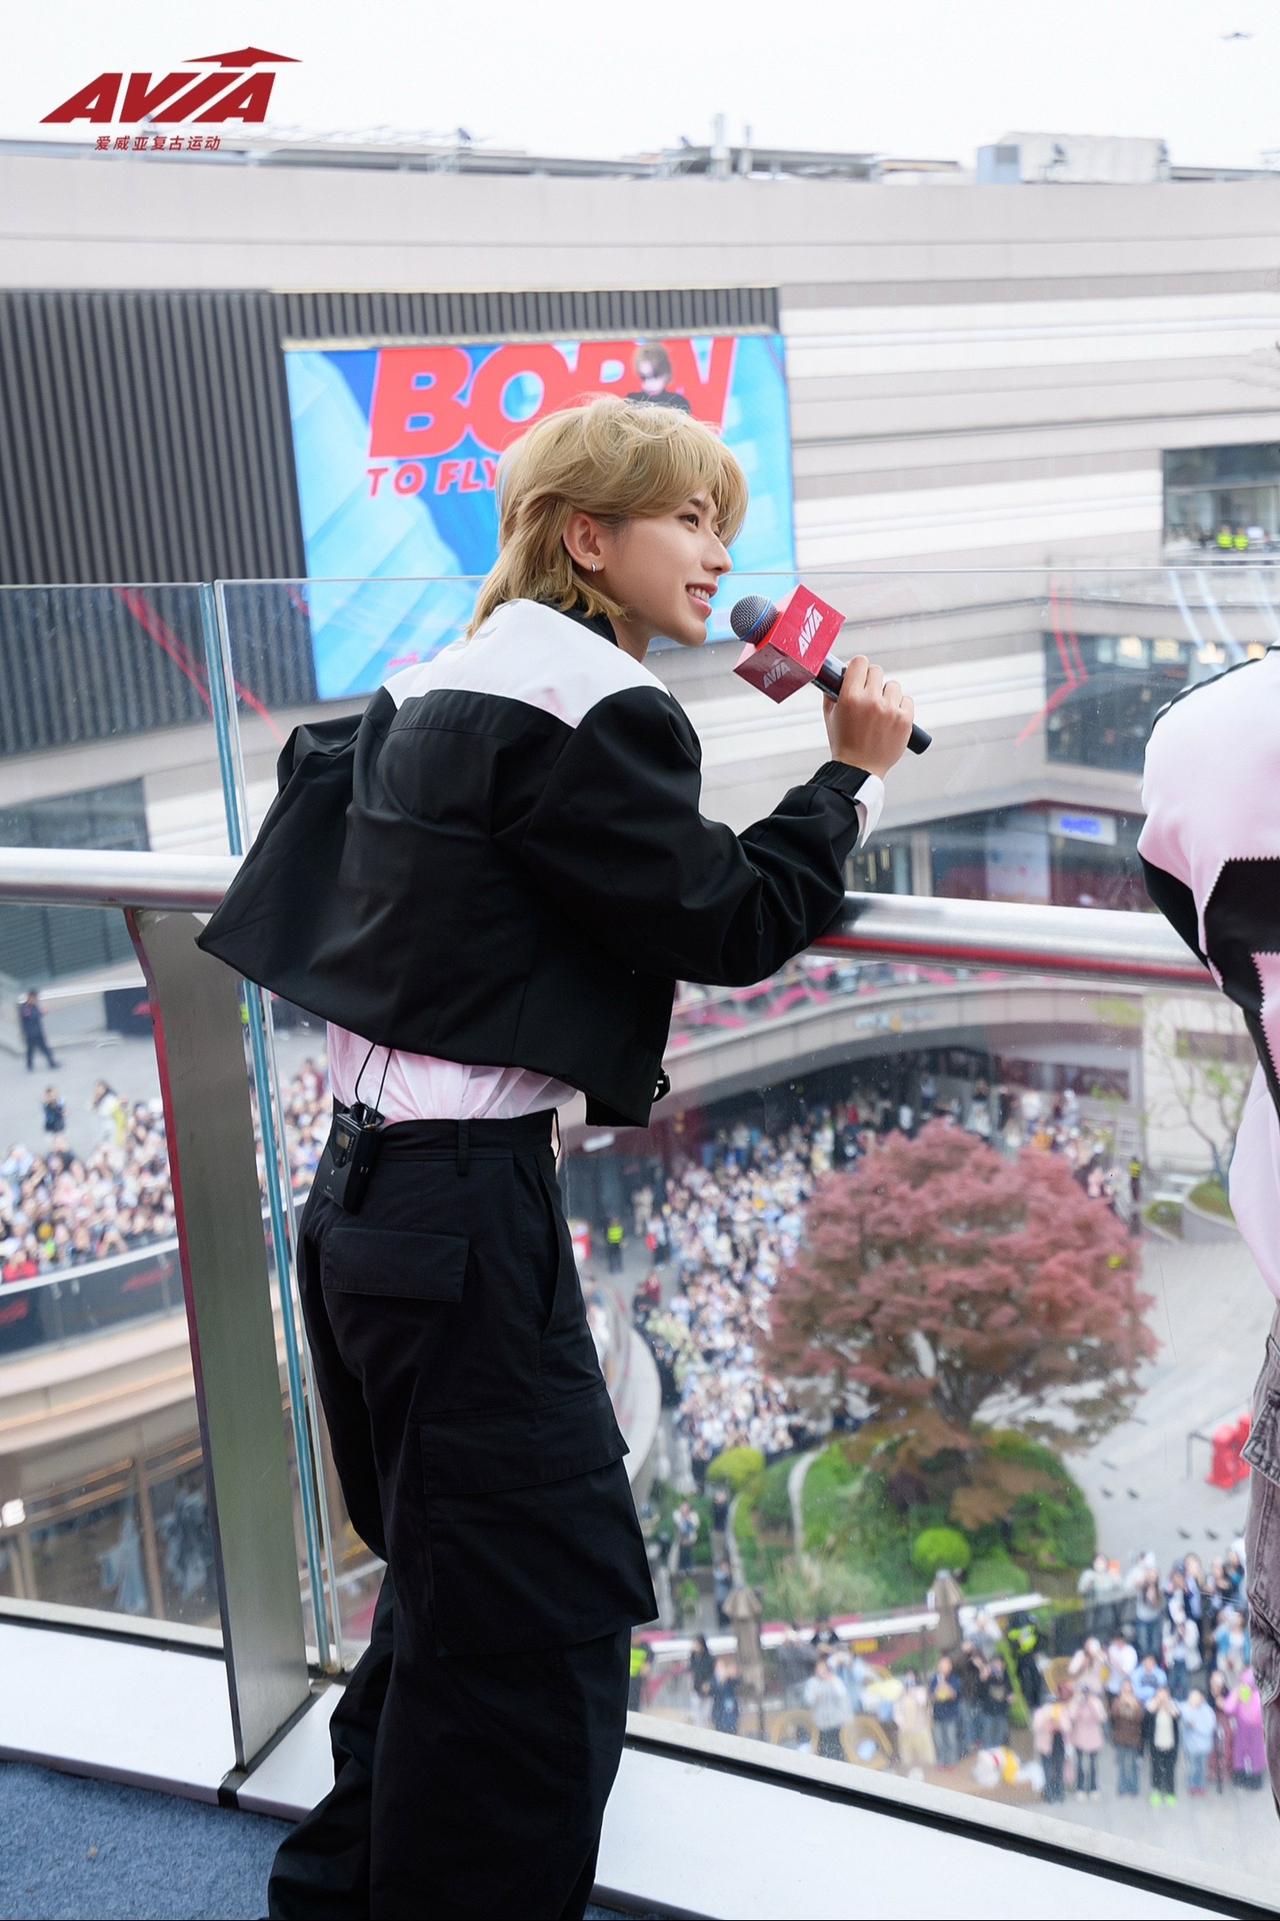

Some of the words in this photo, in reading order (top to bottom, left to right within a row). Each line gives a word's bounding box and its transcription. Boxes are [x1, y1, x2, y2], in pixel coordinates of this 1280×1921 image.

[366, 465, 426, 498] TO
[798, 604, 824, 658] AVIA
[763, 659, 791, 689] AVIA
